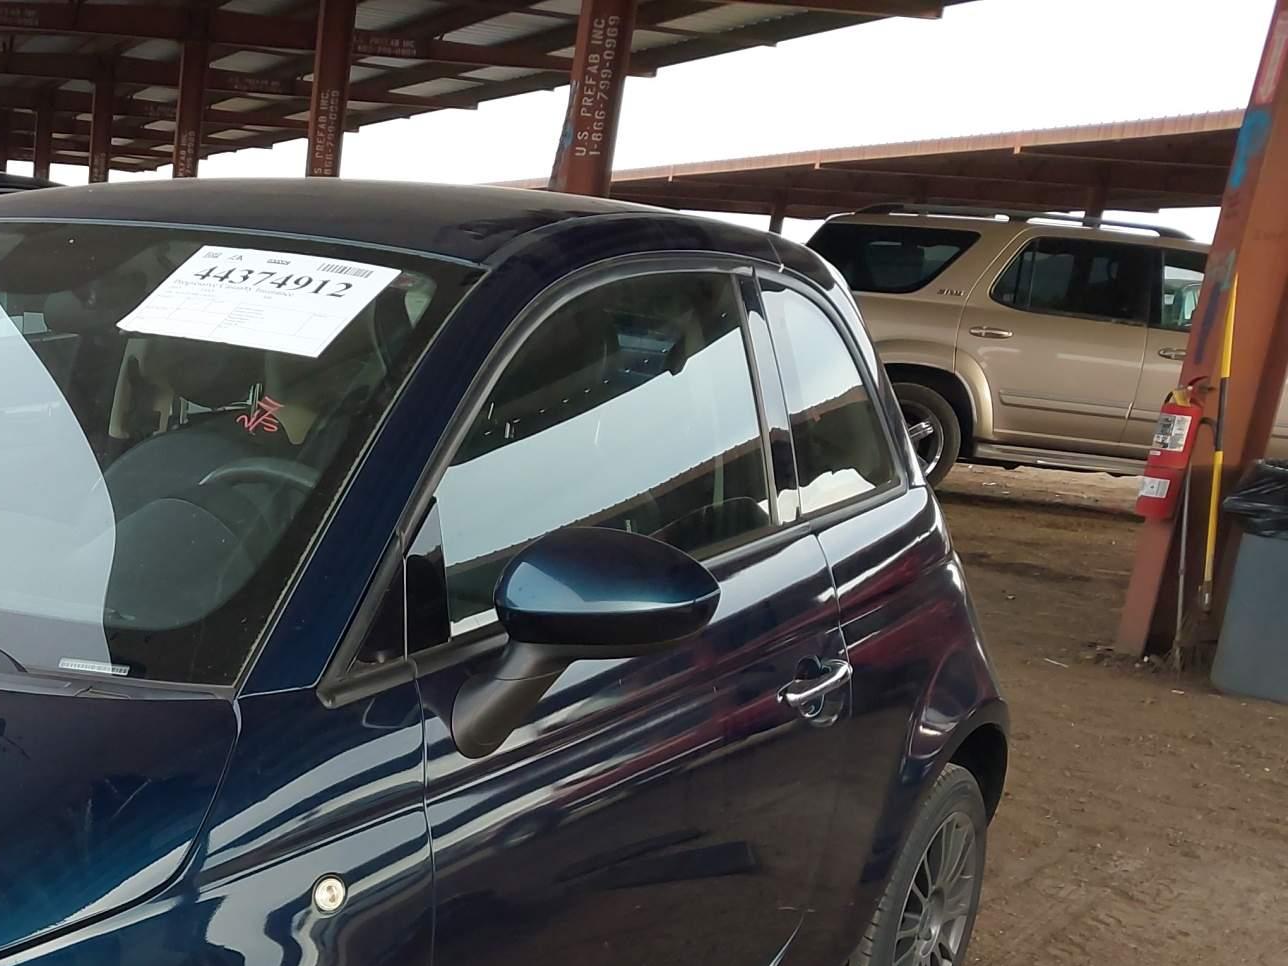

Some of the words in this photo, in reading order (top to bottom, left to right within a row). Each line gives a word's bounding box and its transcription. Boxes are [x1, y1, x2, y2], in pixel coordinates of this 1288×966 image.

[580, 53, 601, 117] PREFAB
[574, 125, 590, 156] U.S.
[193, 264, 353, 298] 44374912
